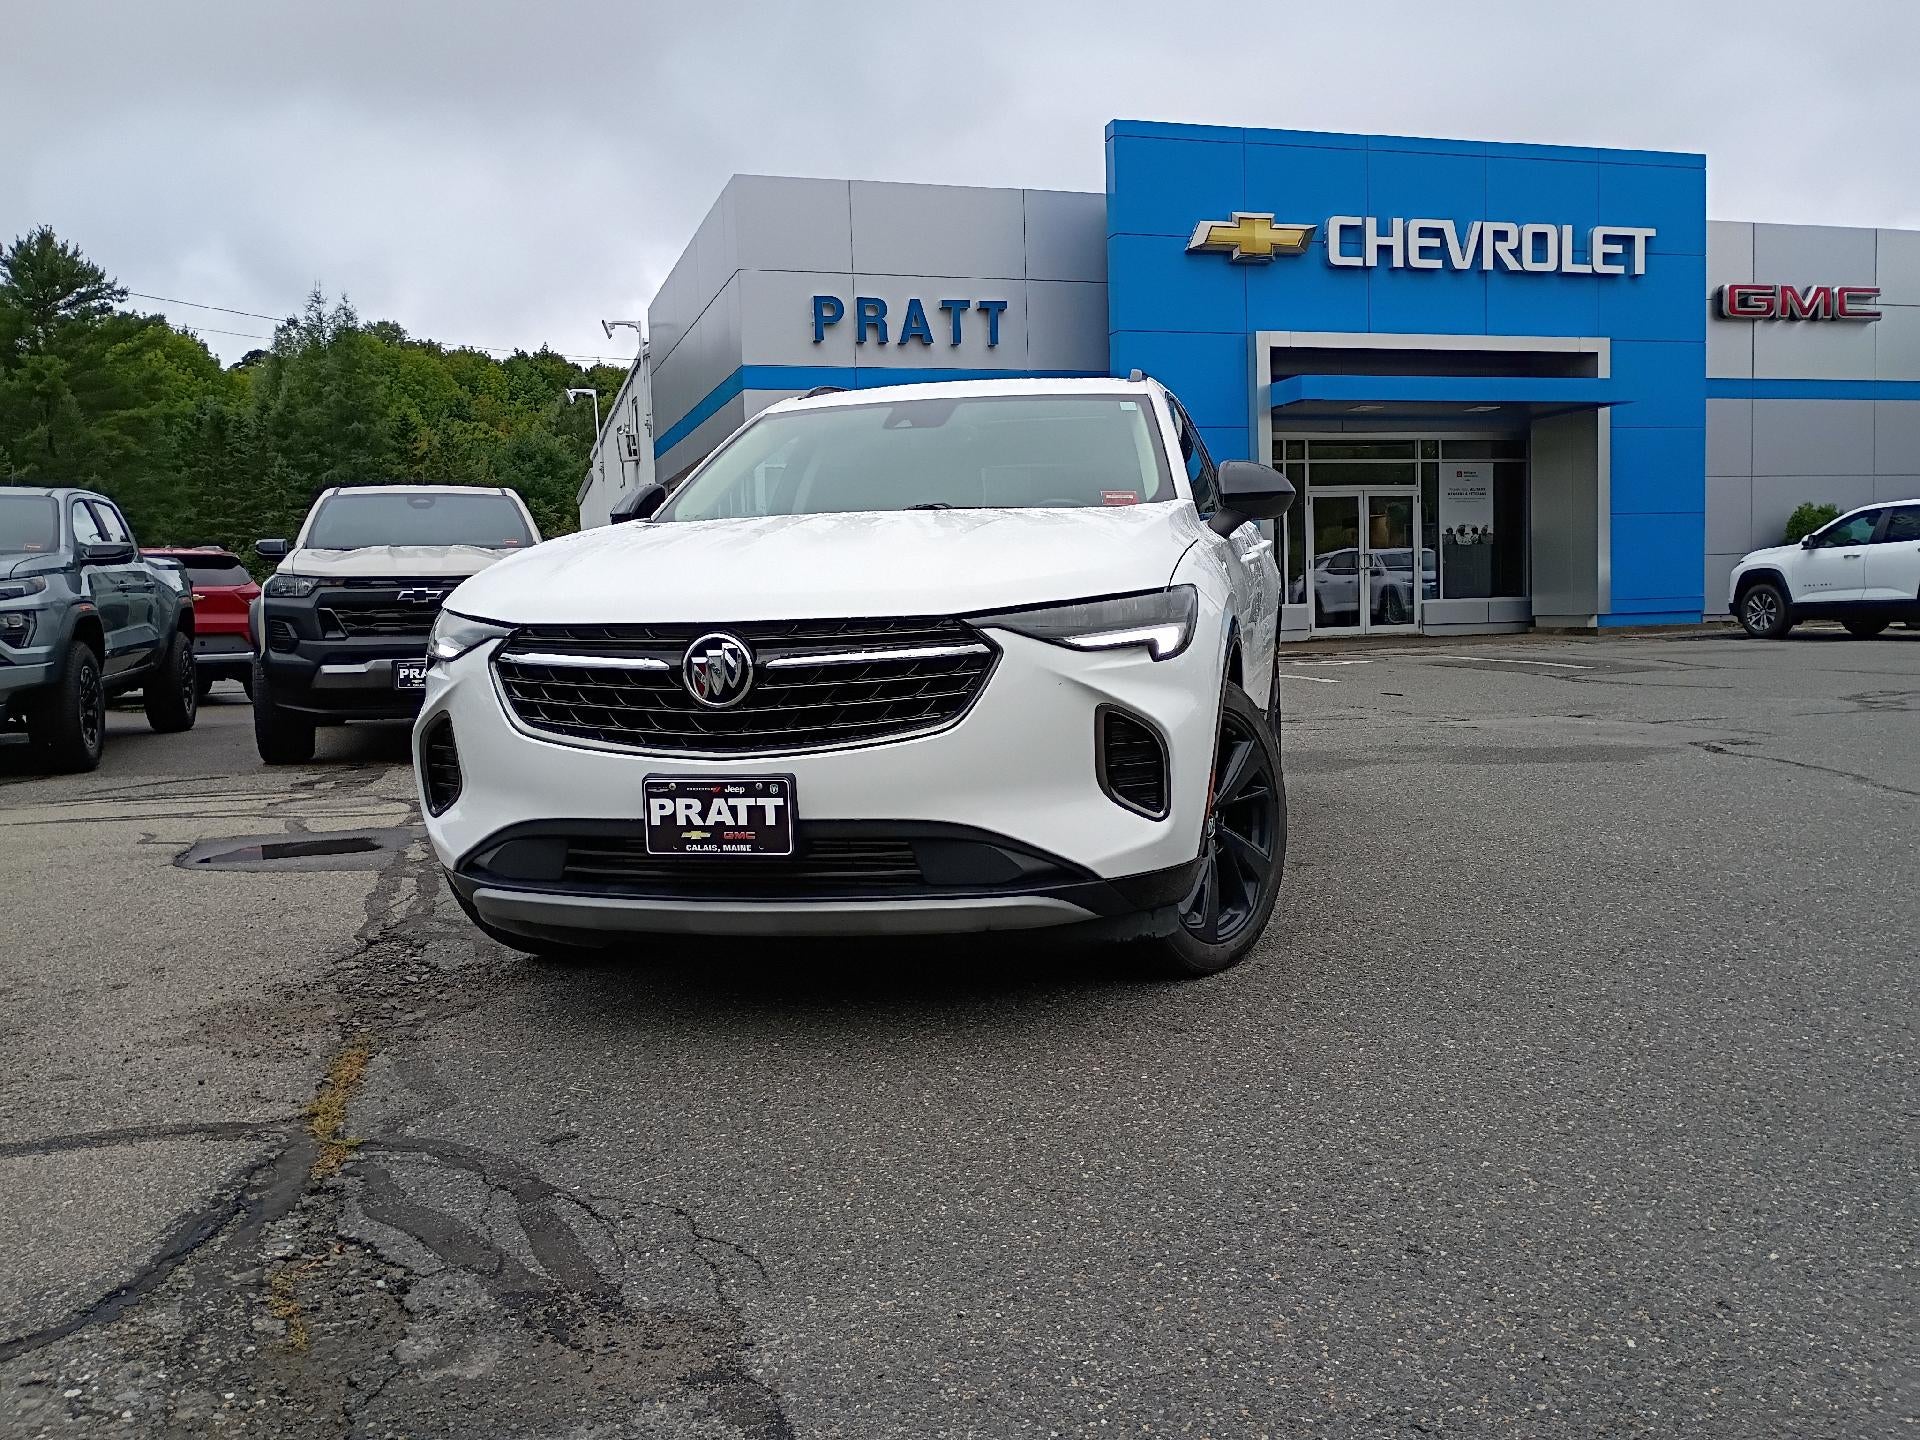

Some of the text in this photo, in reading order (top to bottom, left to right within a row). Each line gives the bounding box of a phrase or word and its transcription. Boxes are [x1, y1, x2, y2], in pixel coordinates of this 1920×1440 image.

[1325, 215, 1657, 276] CHEVROLET
[1722, 284, 1882, 320] GMC
[812, 295, 1008, 347] PRATT
[399, 668, 427, 679] PRA
[724, 785, 746, 795] Jeep
[650, 798, 784, 826] PRATT
[723, 831, 756, 840] GMC
[686, 844, 752, 852] CALAIS, MAINE
